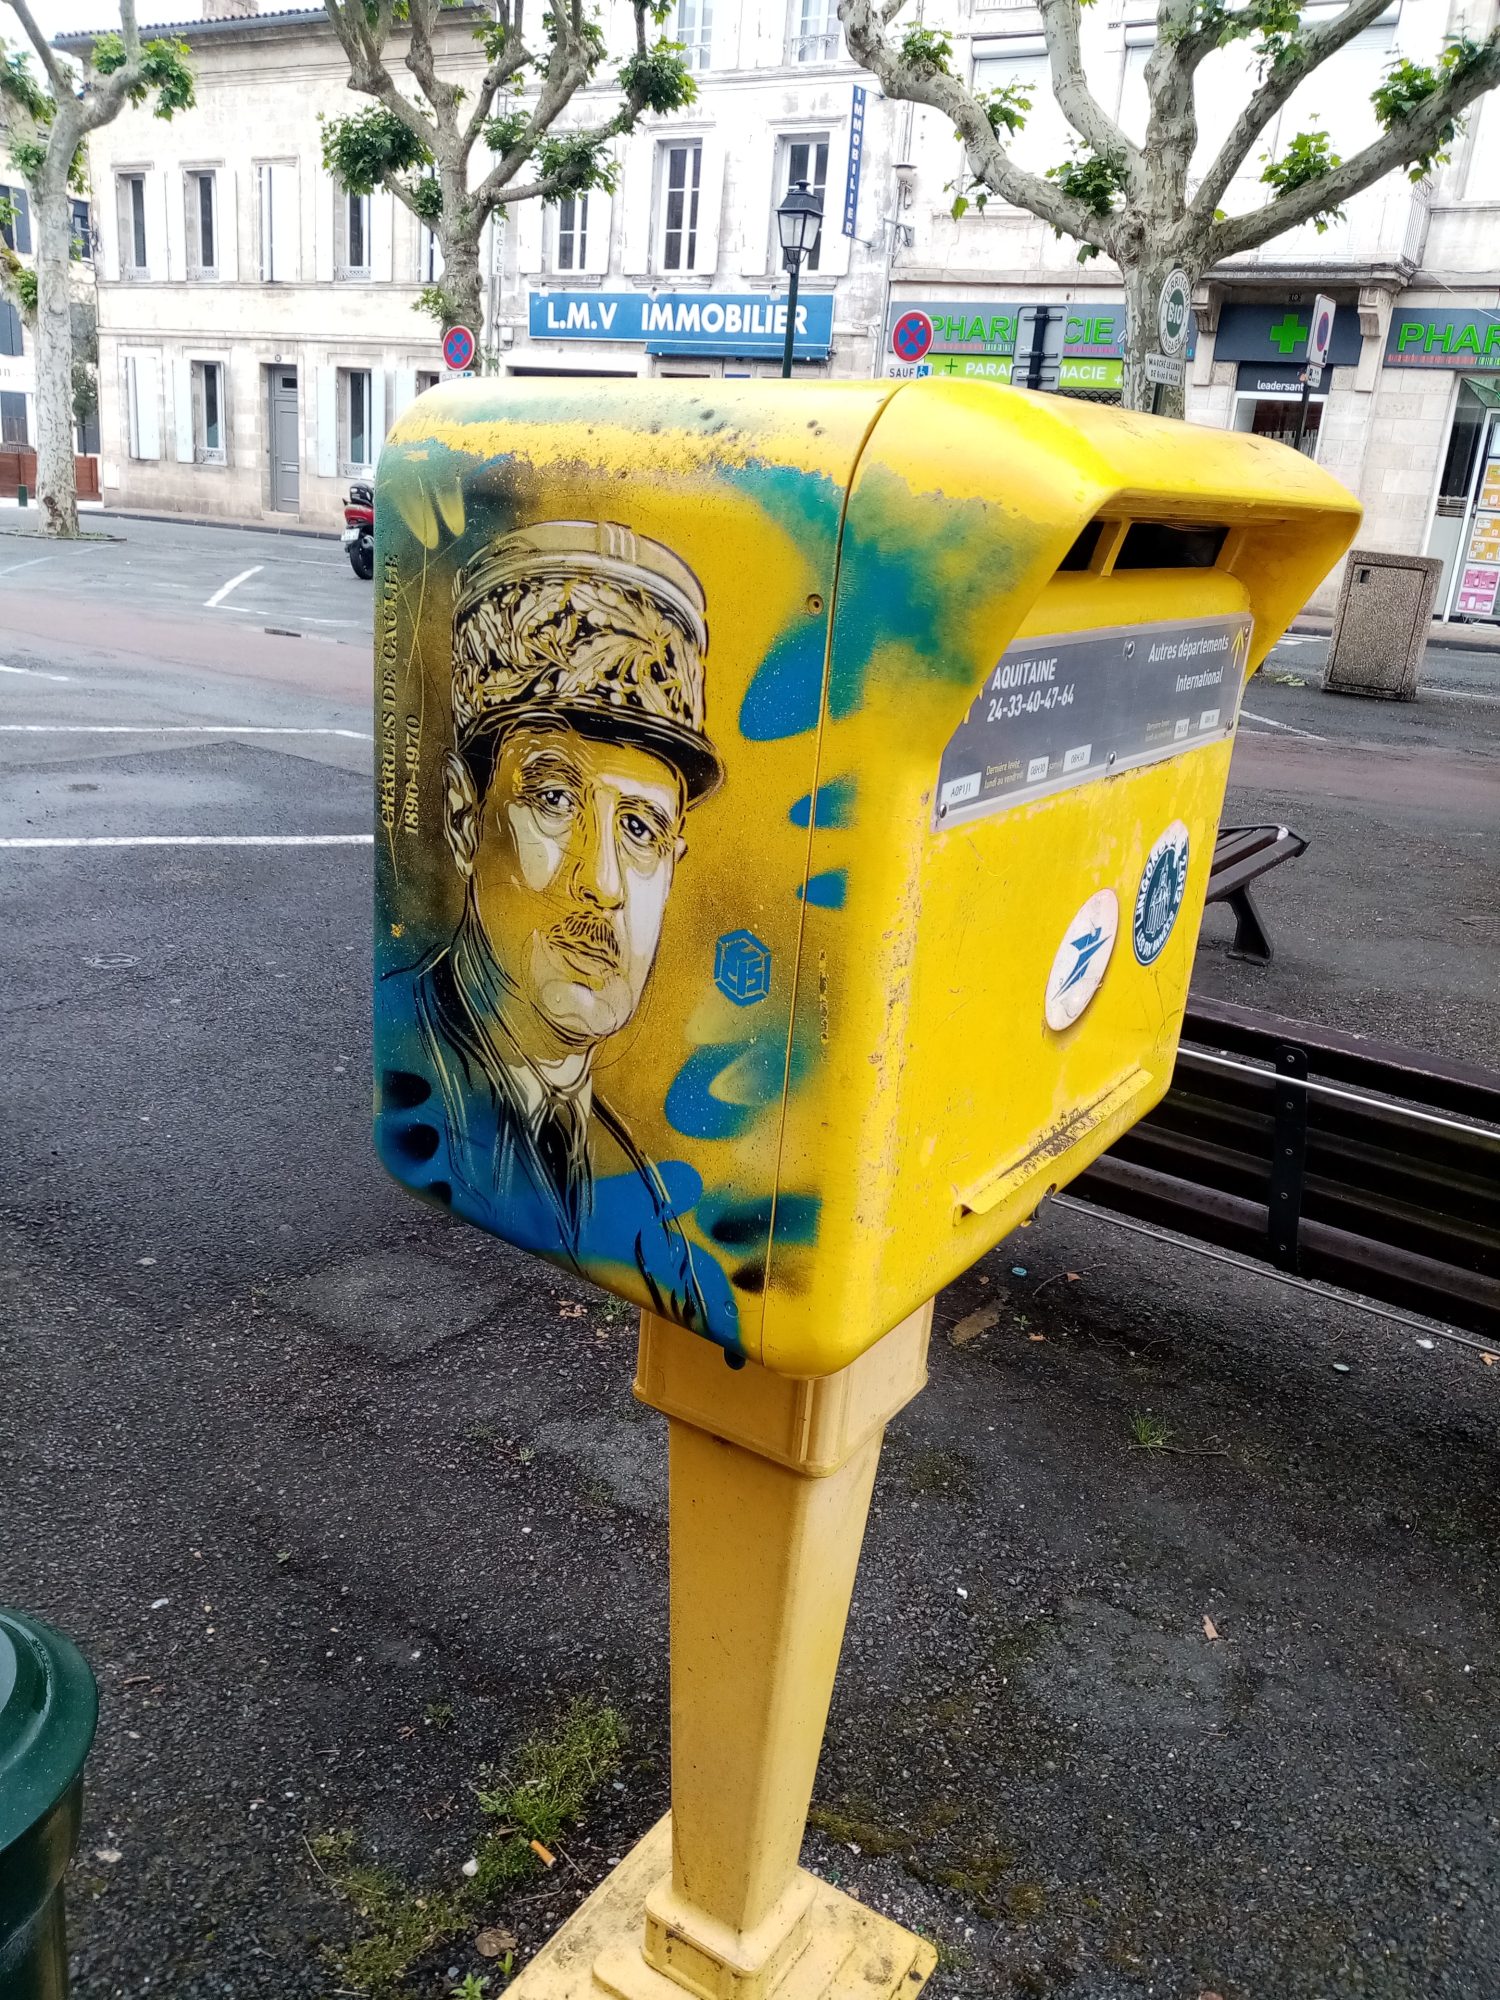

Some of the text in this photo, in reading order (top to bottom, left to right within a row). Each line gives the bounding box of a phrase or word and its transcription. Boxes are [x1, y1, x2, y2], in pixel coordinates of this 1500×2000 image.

[845, 88, 863, 235] IMMOBILIER
[547, 301, 808, 335] L.M.V IMMOBILIER
[1167, 301, 1183, 325] BIO
[928, 315, 1115, 345] PHARCIE
[889, 366, 914, 378] SAUF
[965, 362, 1107, 380] PARAMACIE
[1257, 380, 1304, 392] leadersant
[1148, 634, 1229, 663] Autres départements
[382, 668, 397, 707] DE
[992, 657, 1058, 691] AQUITAINE
[1175, 666, 1224, 693] International
[987, 684, 1075, 722] 24-33-40-47-64
[381, 711, 397, 829] CHARLES
[404, 714, 421, 836] 1890-1970
[1173, 853, 1188, 905] 2012
[1136, 928, 1146, 953] LES
